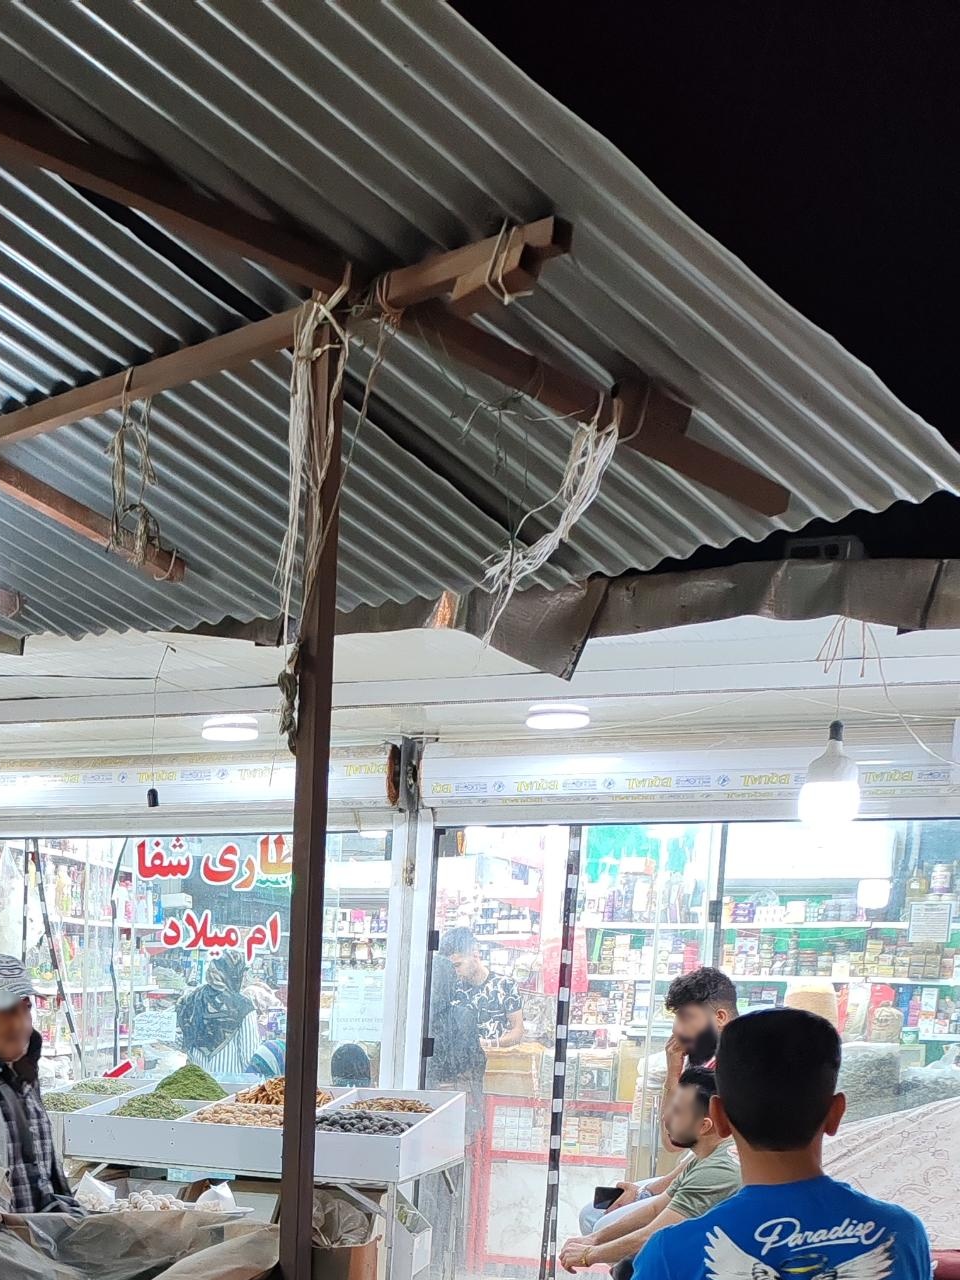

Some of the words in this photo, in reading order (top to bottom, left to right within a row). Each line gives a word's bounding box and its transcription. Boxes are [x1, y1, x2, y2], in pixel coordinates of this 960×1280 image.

[514, 778, 559, 793] EQUAL
[625, 776, 673, 789] EQUAL
[742, 772, 790, 787] EQUAL
[862, 769, 912, 784] EQUAL
[136, 836, 190, 878] شفا
[202, 834, 293, 889] طاری
[162, 910, 239, 957] میلاد
[246, 912, 279, 962] ام
[754, 1217, 886, 1256] Paradise
